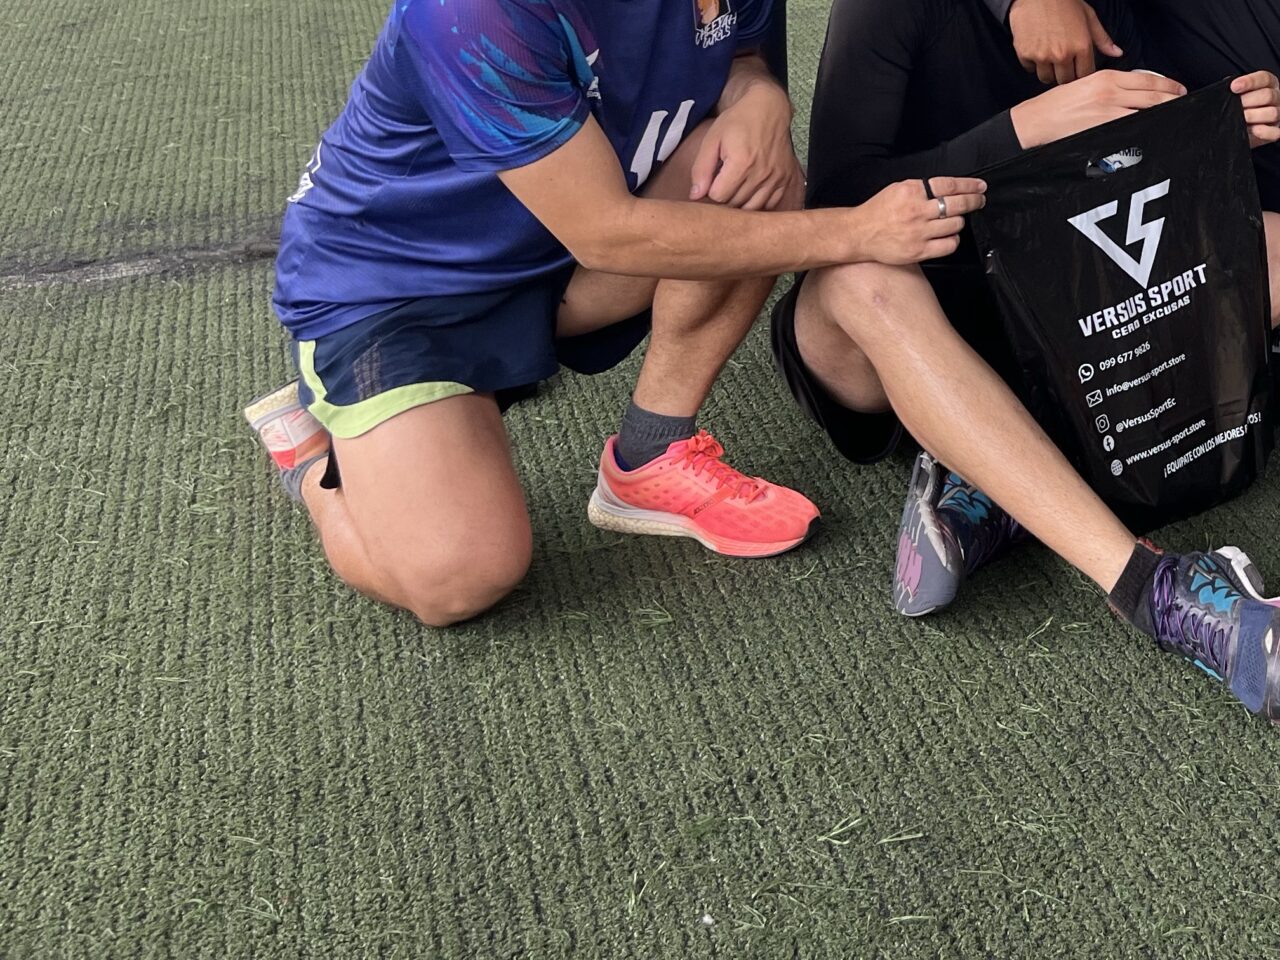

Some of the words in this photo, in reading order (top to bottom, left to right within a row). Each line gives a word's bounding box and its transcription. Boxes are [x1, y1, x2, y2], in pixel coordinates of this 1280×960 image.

[1078, 292, 1148, 337] VERSUS
[1147, 263, 1208, 307] SPORT
[1111, 319, 1141, 339] CERO
[1142, 295, 1191, 325] EXCUSAS
[1099, 356, 1116, 371] 099
[1116, 350, 1133, 364] 677
[1105, 353, 1186, 397] info@versus-sport.store
[1115, 397, 1177, 433] @VersusSportEc
[1125, 418, 1207, 466] www.versus-sport.store
[1192, 443, 1206, 459] CON
[1204, 439, 1216, 452] LOS
[1214, 426, 1245, 446] MEJORES
